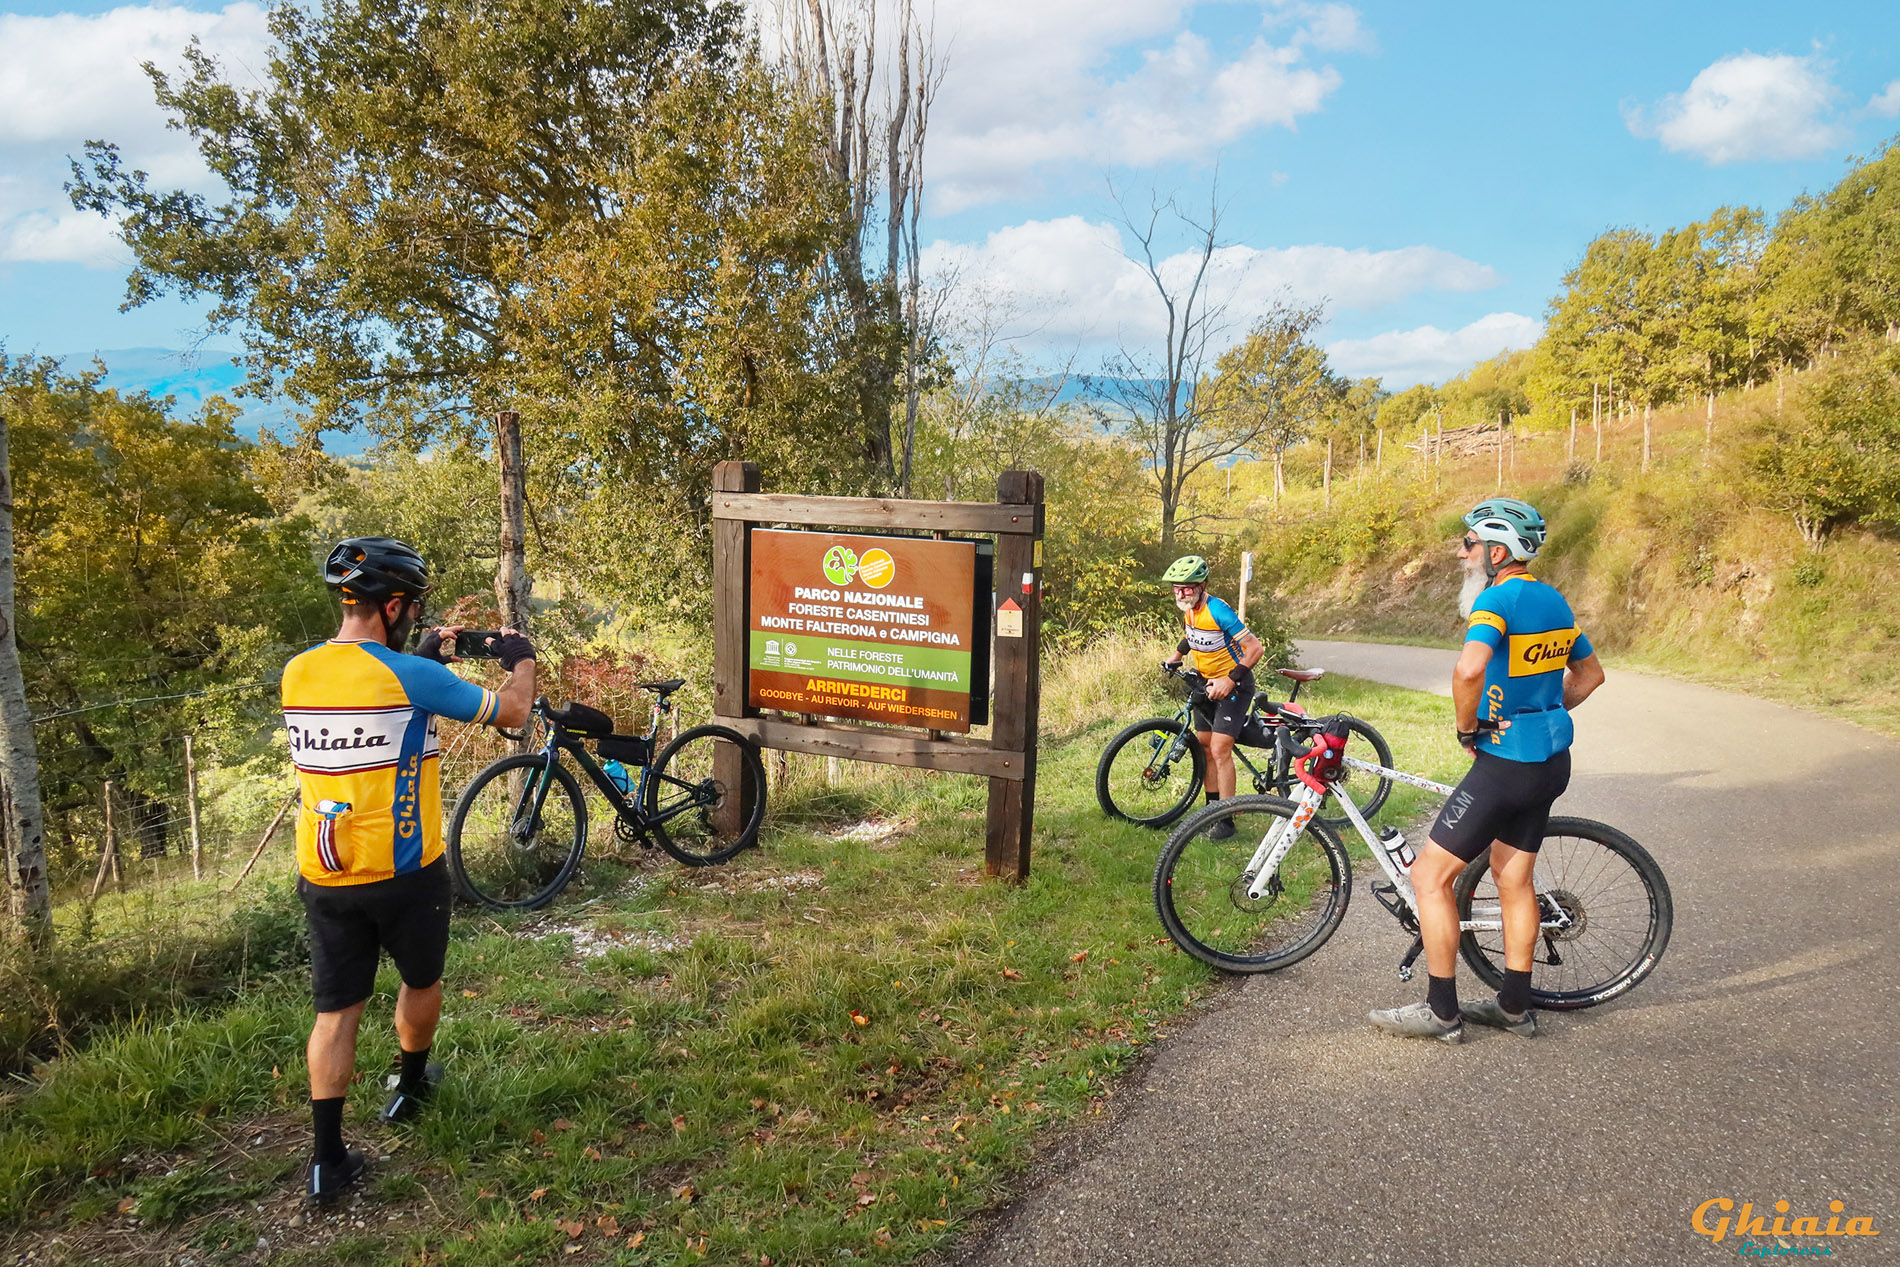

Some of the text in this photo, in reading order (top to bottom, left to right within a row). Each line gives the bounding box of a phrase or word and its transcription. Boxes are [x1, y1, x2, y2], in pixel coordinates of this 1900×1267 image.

[794, 586, 924, 609] PARCO NAZIONALE
[788, 602, 930, 626] FORESTE CASENTINESI
[760, 615, 960, 645] MONTE FALTERONA e CAMPIGNA
[827, 647, 904, 664] NELLE FORESTE
[827, 659, 886, 675] PATRIMONIO
[887, 665, 959, 683] DELL'UMANITÀ
[806, 678, 907, 702] ARRIVEDERCI
[759, 688, 804, 702] GOODBYE
[811, 694, 825, 704] AU
[825, 695, 860, 708] REVOIR
[867, 701, 886, 711] AUF
[887, 703, 958, 720] WIEDERSEHEN
[288, 725, 391, 751] Ghiaia
[398, 752, 419, 839] Ghiaia
[1589, 977, 1632, 1001] MEZCAL
